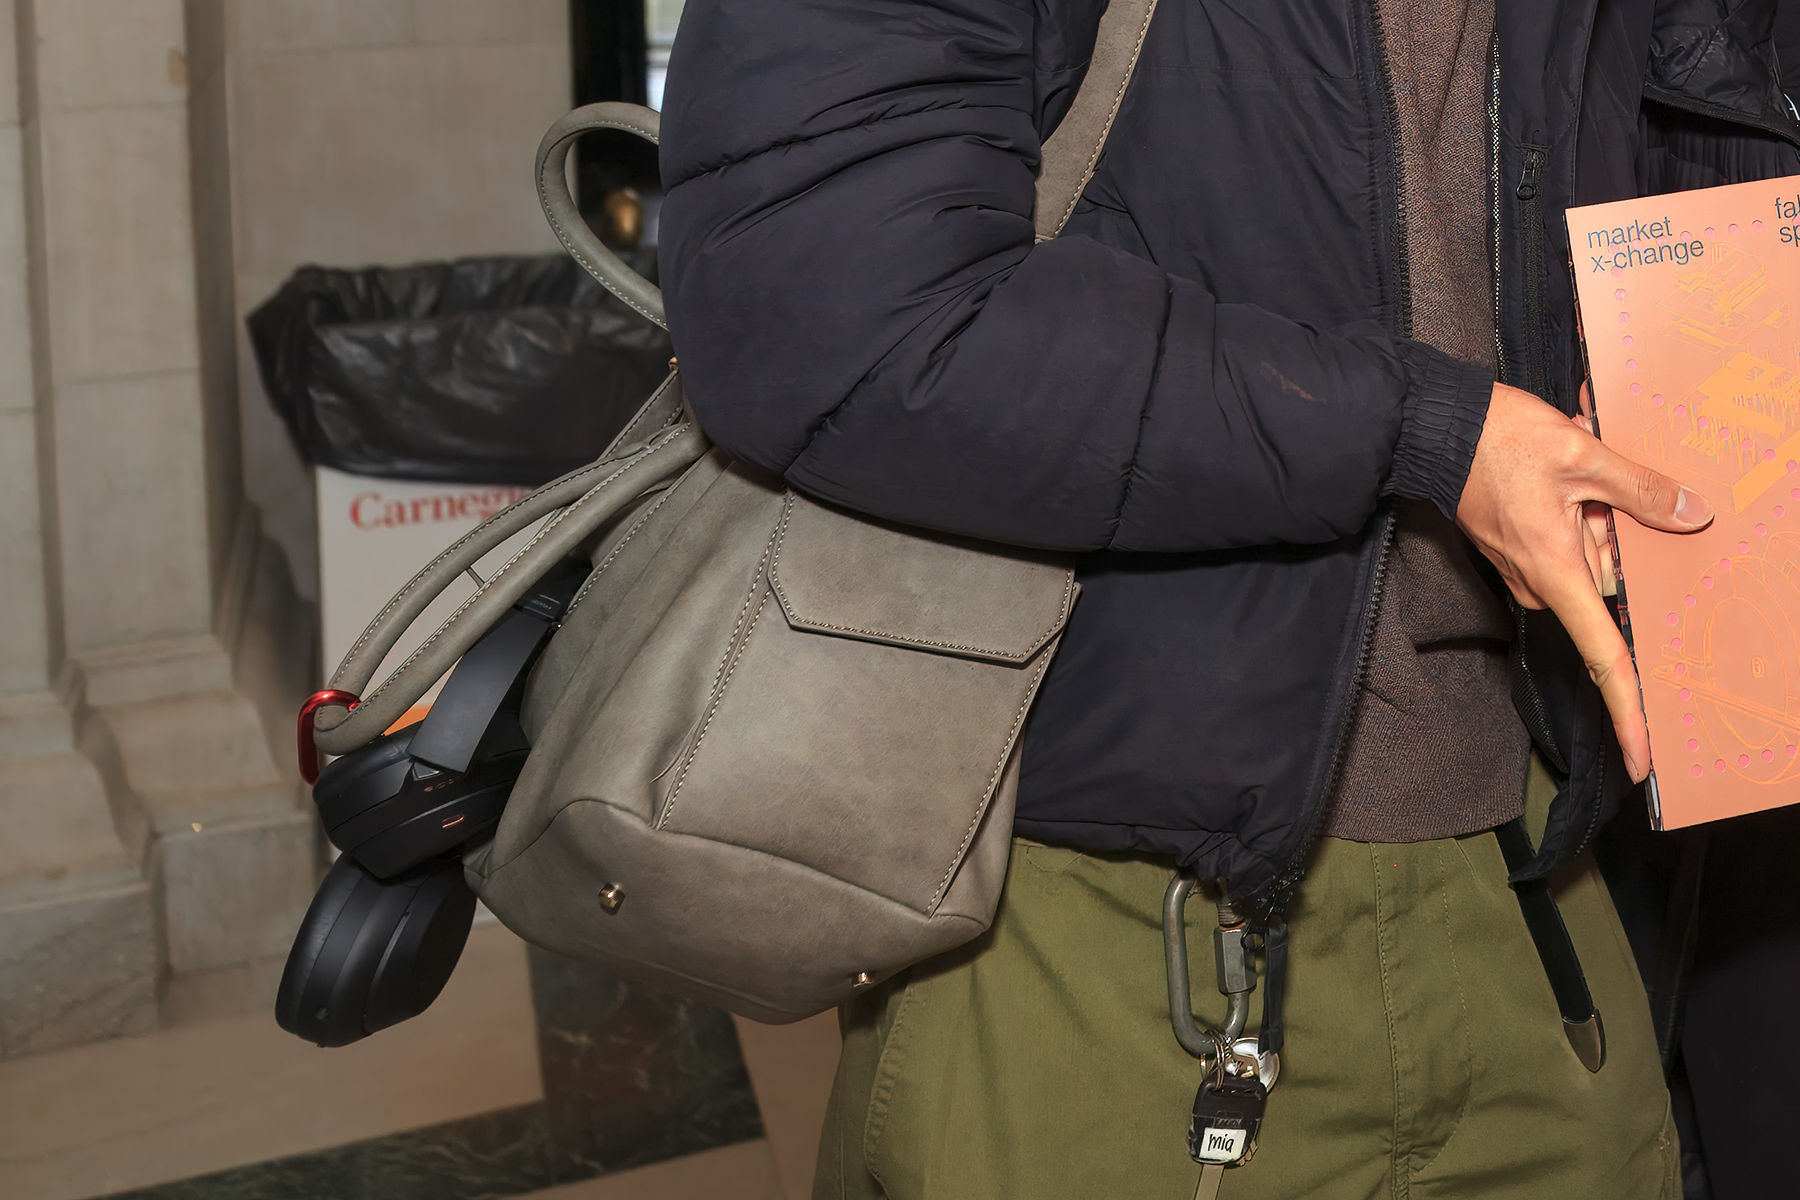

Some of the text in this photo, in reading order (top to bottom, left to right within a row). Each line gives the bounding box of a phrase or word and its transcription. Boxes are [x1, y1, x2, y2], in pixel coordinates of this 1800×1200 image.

[1587, 216, 1672, 249] market
[1590, 238, 1704, 273] x-change
[1207, 1133, 1235, 1153] mia
